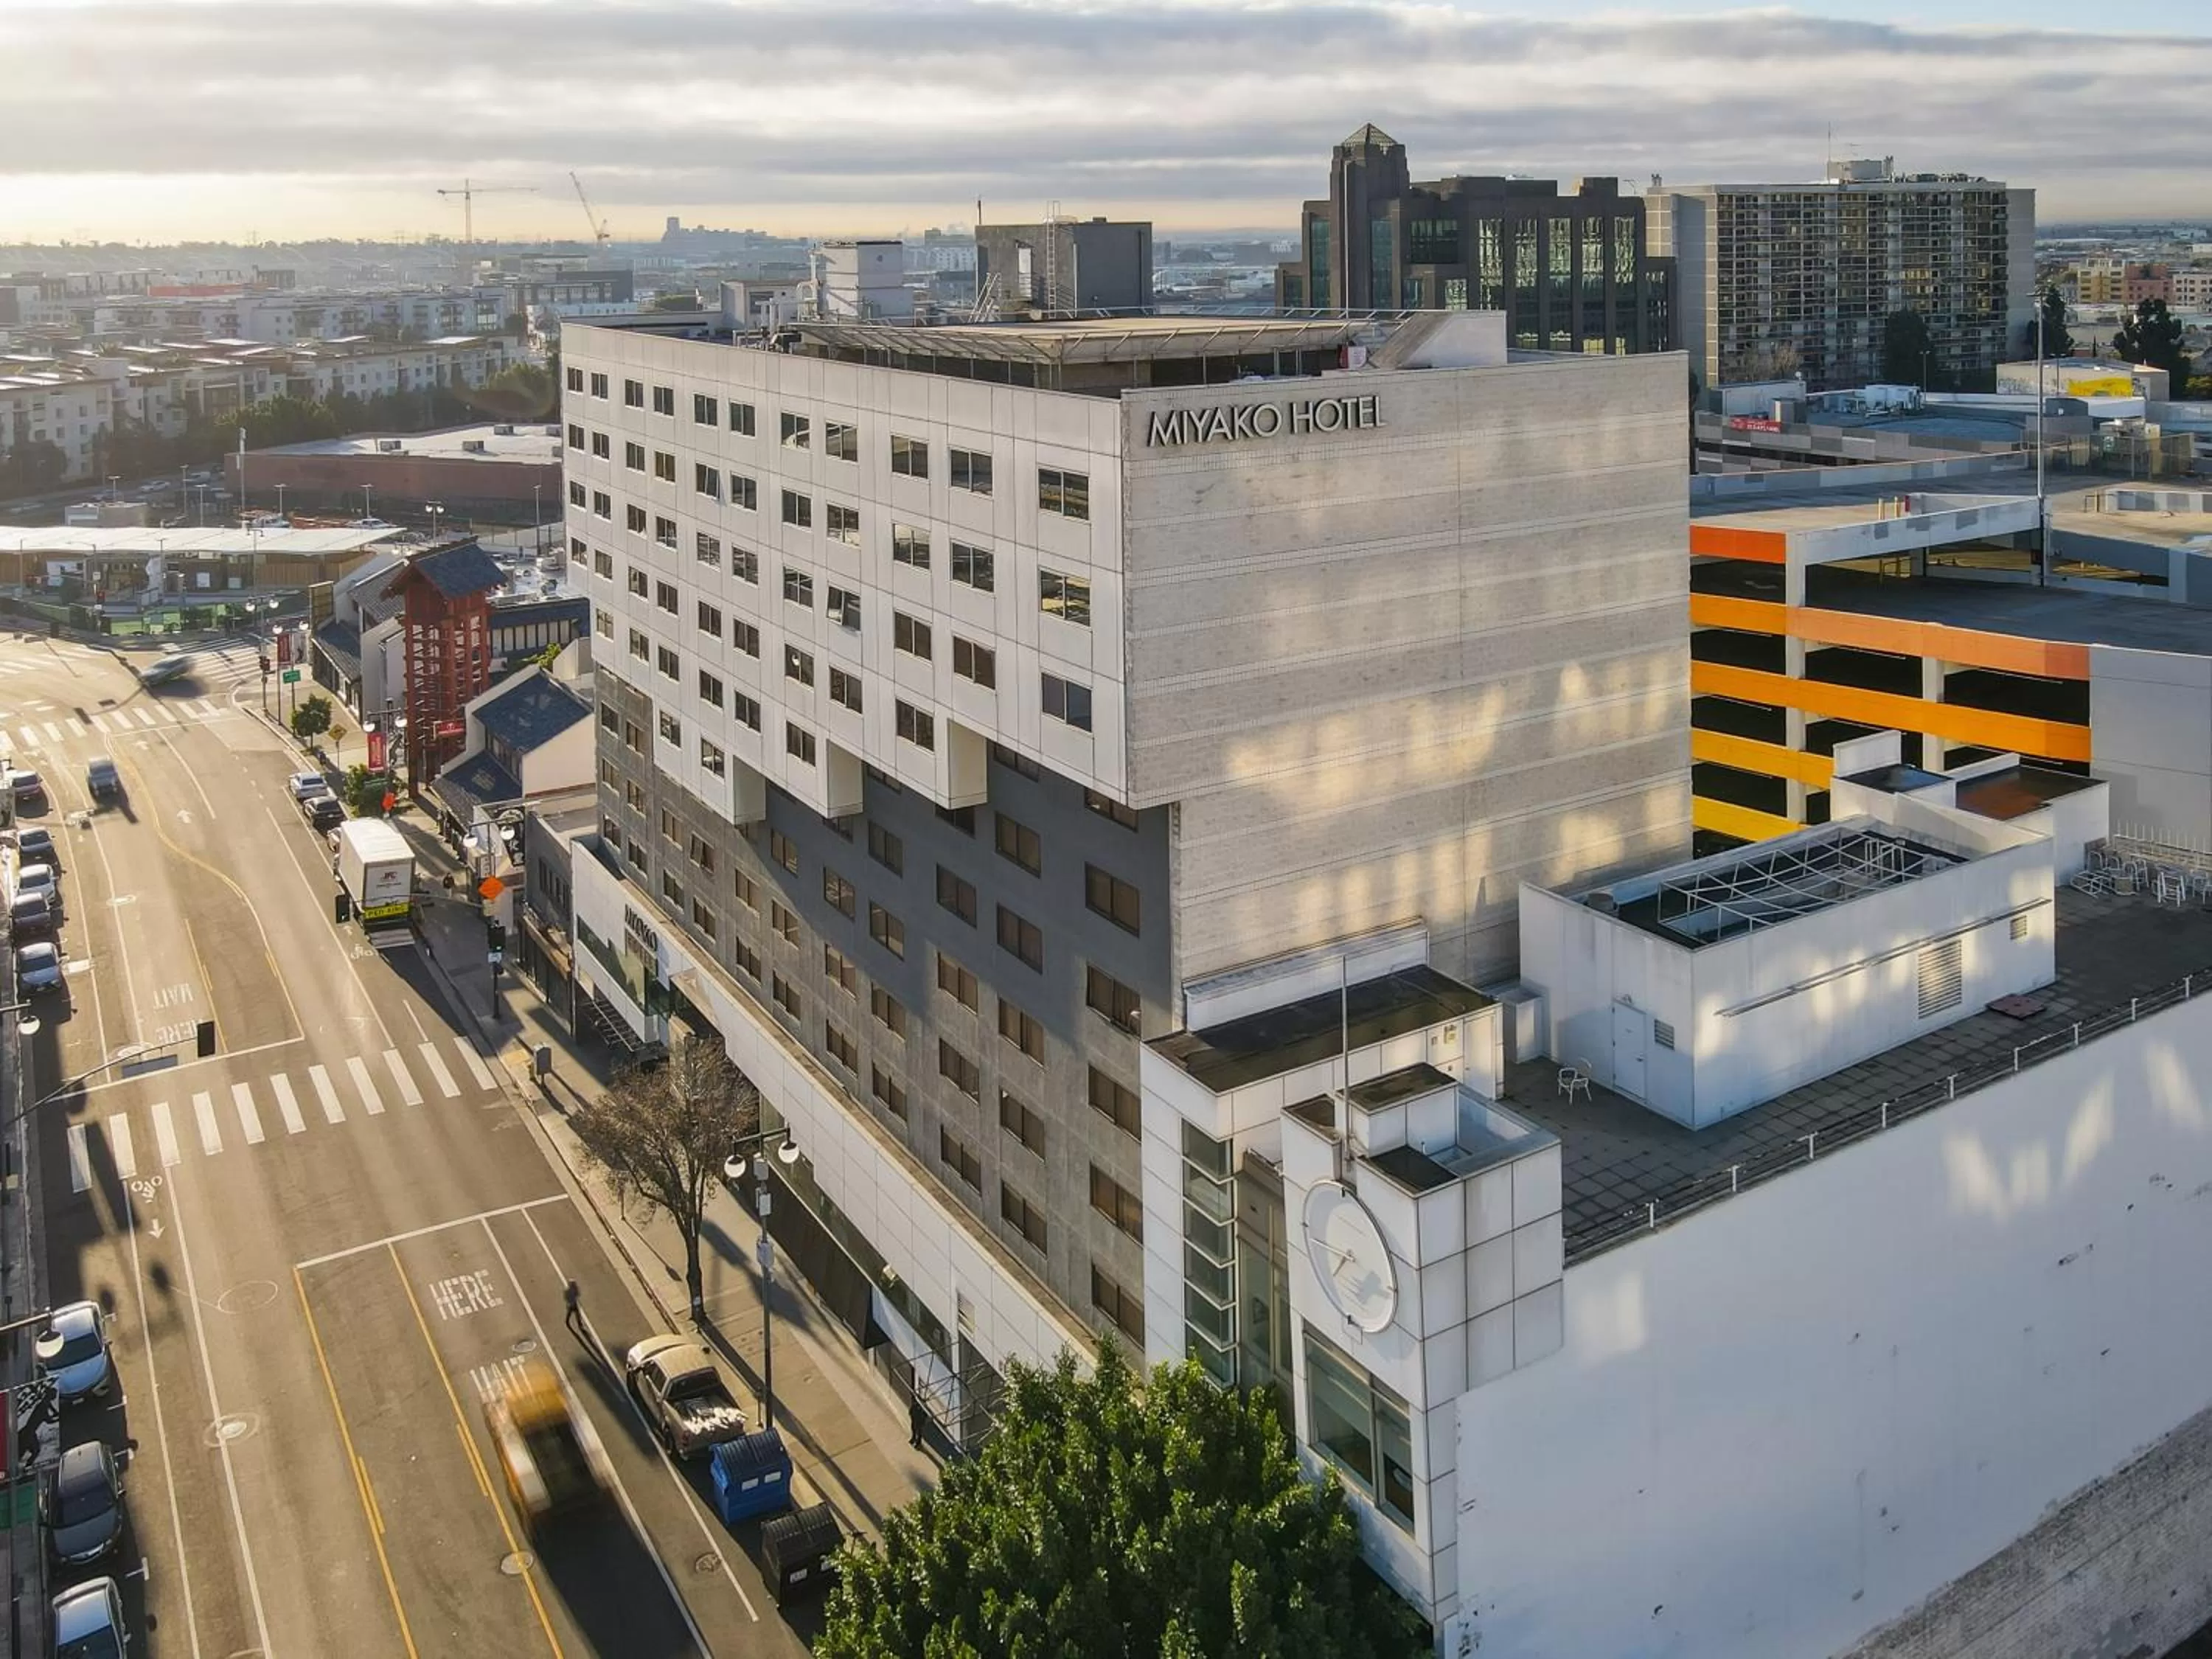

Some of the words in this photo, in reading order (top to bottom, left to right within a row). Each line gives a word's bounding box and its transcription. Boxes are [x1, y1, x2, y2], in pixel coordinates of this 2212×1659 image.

[1147, 403, 1282, 448] MIYAKO
[1290, 395, 1388, 434] HOTEL
[429, 1269, 504, 1321] HERE
